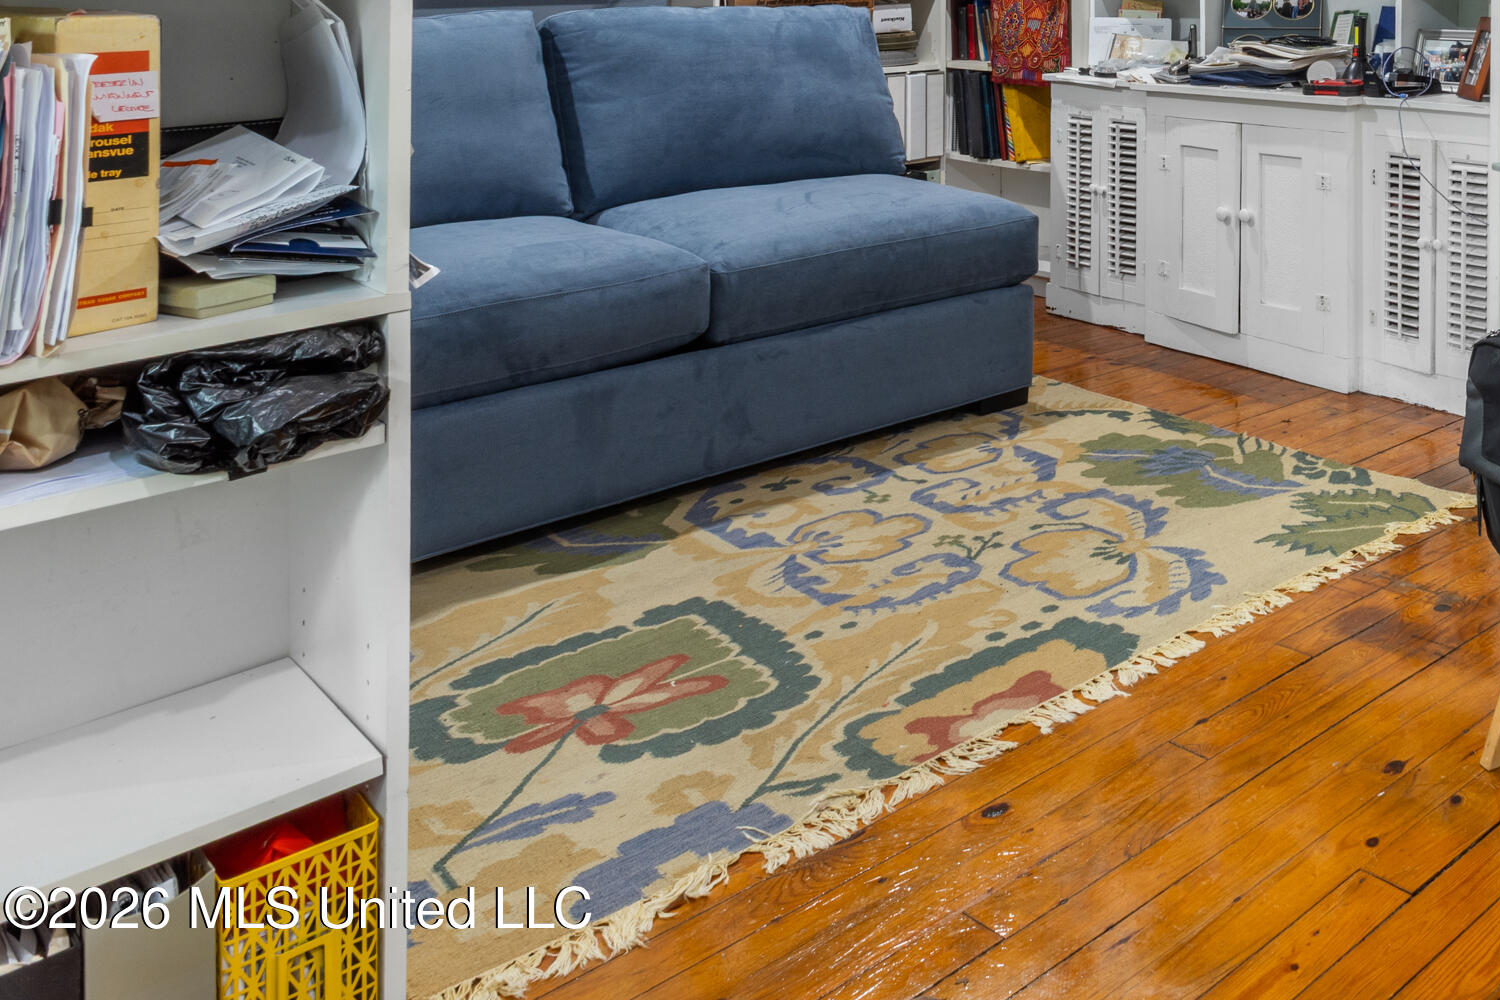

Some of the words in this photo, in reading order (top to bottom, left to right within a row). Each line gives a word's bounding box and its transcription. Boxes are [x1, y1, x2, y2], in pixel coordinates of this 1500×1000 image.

[90, 123, 114, 133] dak
[91, 135, 132, 148] rousel
[88, 147, 134, 159] ansvue
[100, 169, 122, 179] tray
